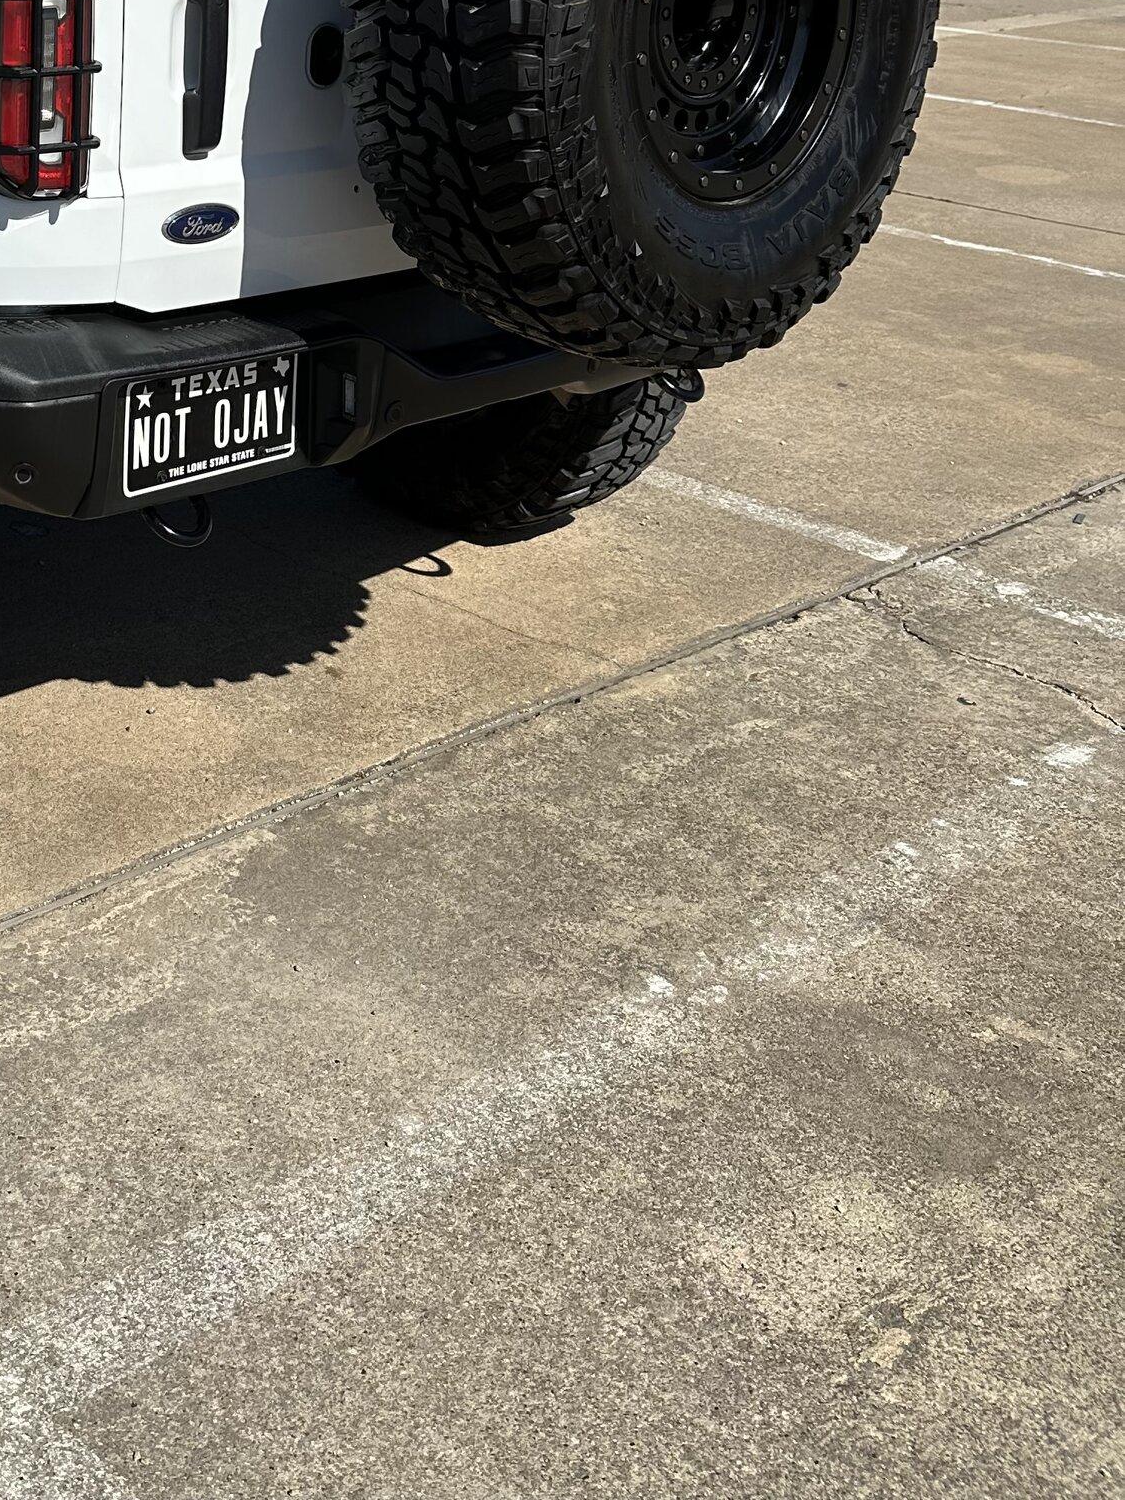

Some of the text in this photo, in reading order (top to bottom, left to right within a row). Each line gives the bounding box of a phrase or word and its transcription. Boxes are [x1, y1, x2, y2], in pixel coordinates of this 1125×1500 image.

[182, 215, 223, 237] Ford
[172, 362, 257, 401] TEXAS
[133, 385, 288, 470] NOT OJAY
[169, 466, 185, 478] THE
[187, 460, 208, 474] LONE
[209, 455, 230, 468] STAR
[231, 448, 255, 462] STATE
